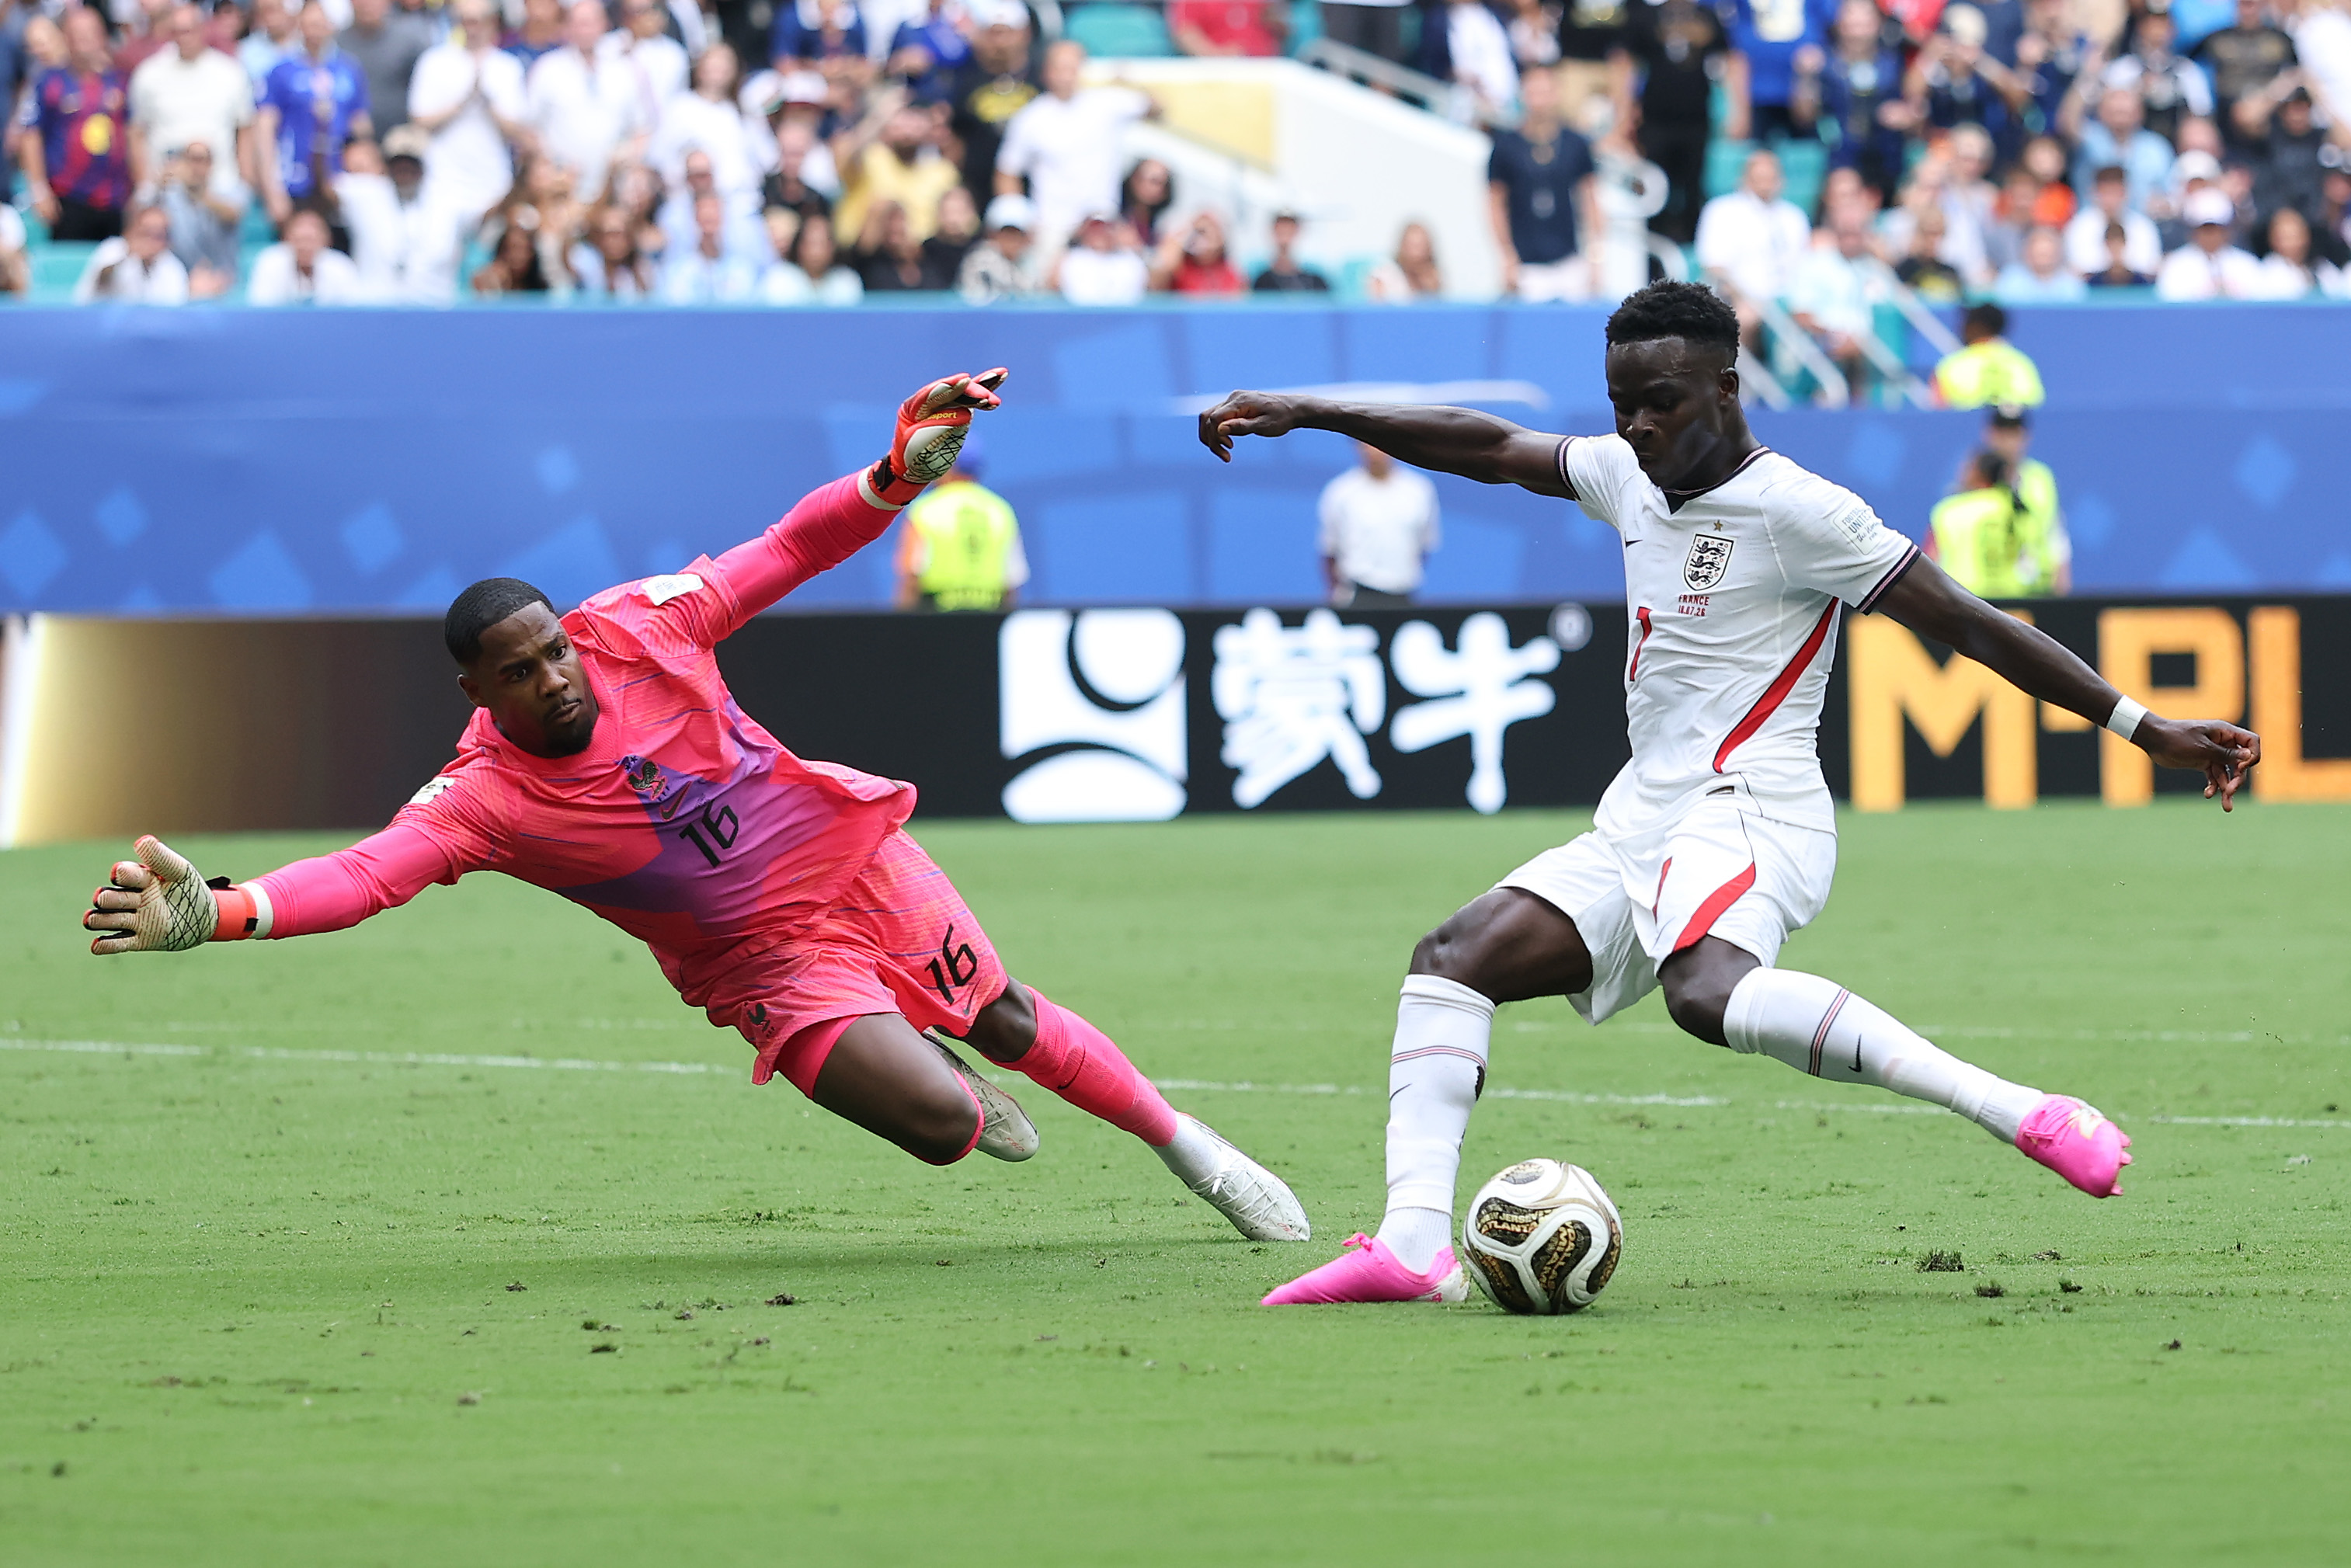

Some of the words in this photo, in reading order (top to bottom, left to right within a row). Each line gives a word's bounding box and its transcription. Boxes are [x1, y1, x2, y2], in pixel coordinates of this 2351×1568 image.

[924, 412, 957, 421] sport
[1678, 594, 1709, 606] FRANCE
[1212, 607, 1561, 815] 蒙牛
[679, 799, 739, 868] 16
[924, 923, 977, 1006] 16
[1481, 1220, 1539, 1234] ATLANTA
